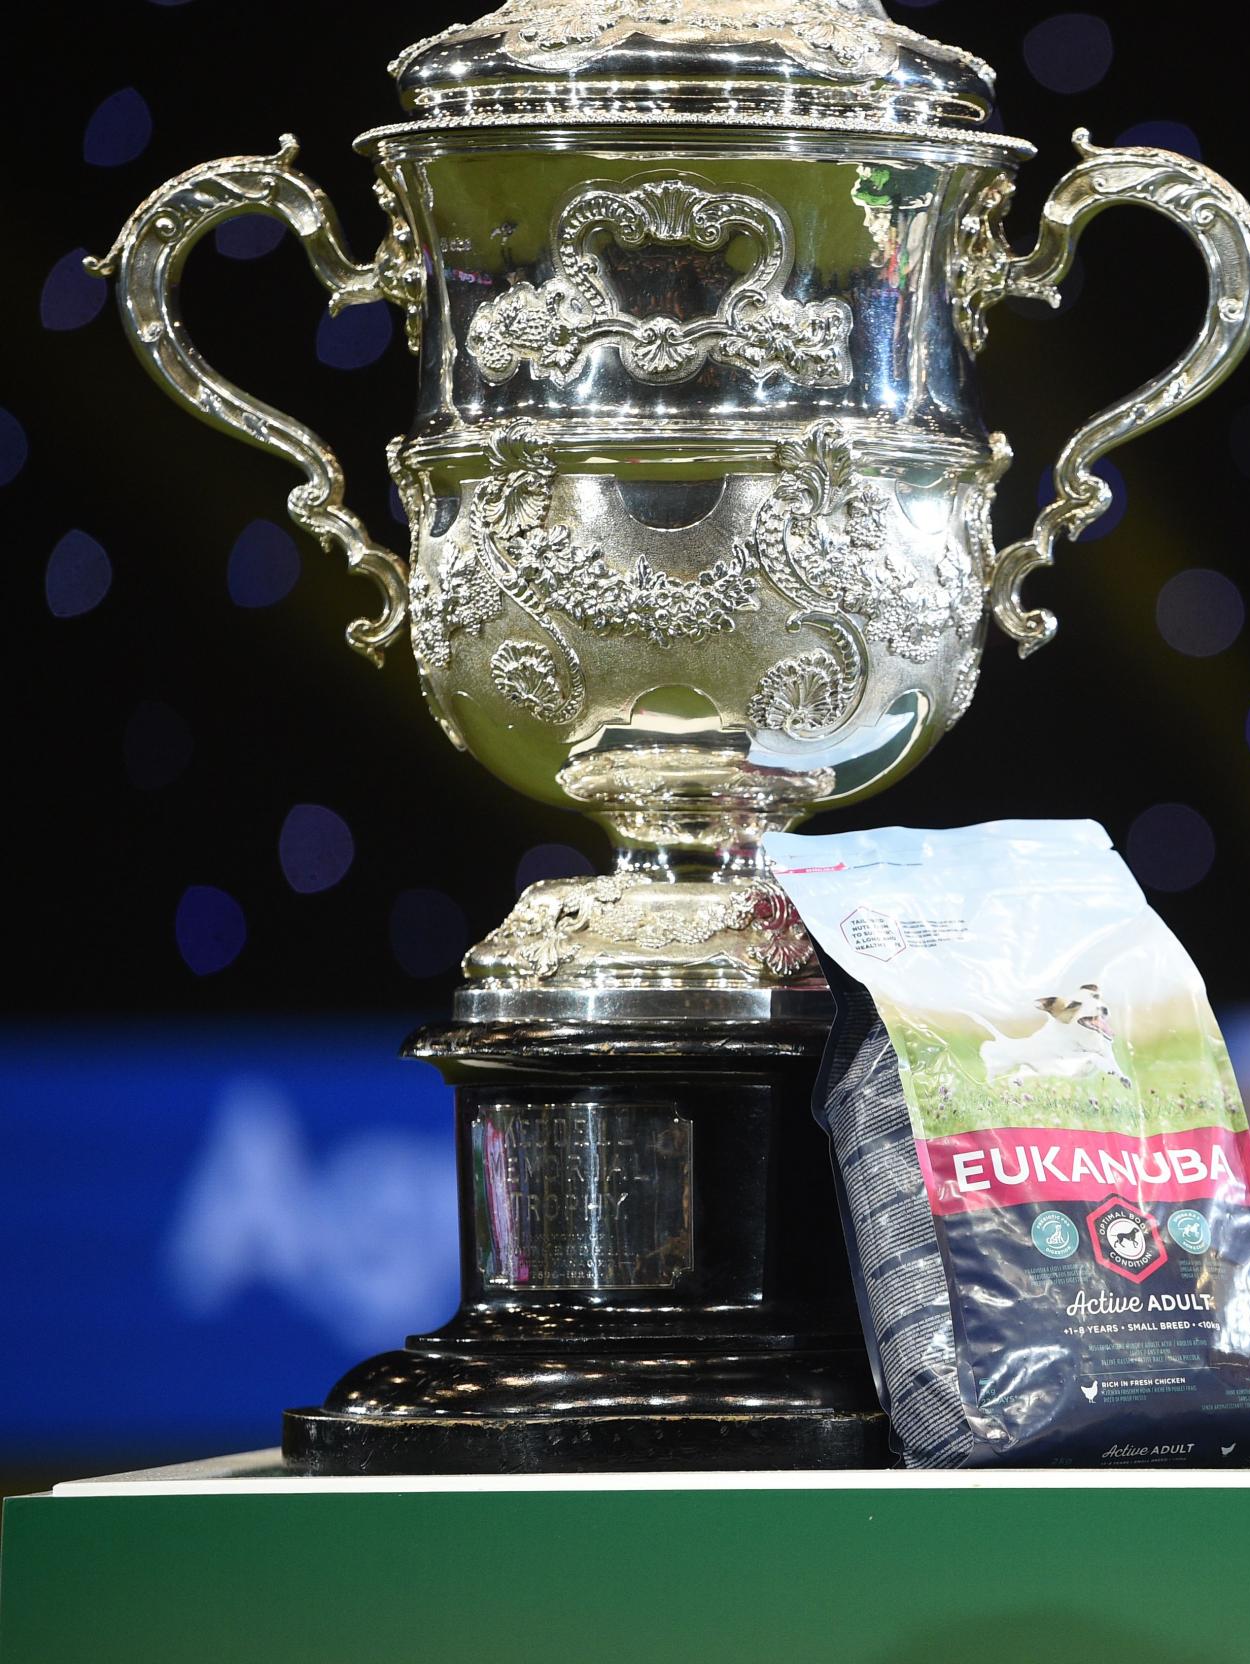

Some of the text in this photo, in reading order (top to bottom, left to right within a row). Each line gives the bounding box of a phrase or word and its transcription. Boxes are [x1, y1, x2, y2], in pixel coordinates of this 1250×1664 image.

[953, 1144, 1236, 1192] EUKANUBA
[511, 1192, 629, 1221] TROPHY
[1099, 1211, 1127, 1236] OPTIMAL
[1129, 1213, 1149, 1234] BODY
[1109, 1251, 1153, 1268] CONDITION
[1066, 1290, 1211, 1316] Active ADULT
[1063, 1321, 1221, 1335] +1-8 YEARS SMALL BREED <10kg
[1154, 1377, 1186, 1385] CHICKEN
[1101, 1443, 1196, 1459] Active ADULT
